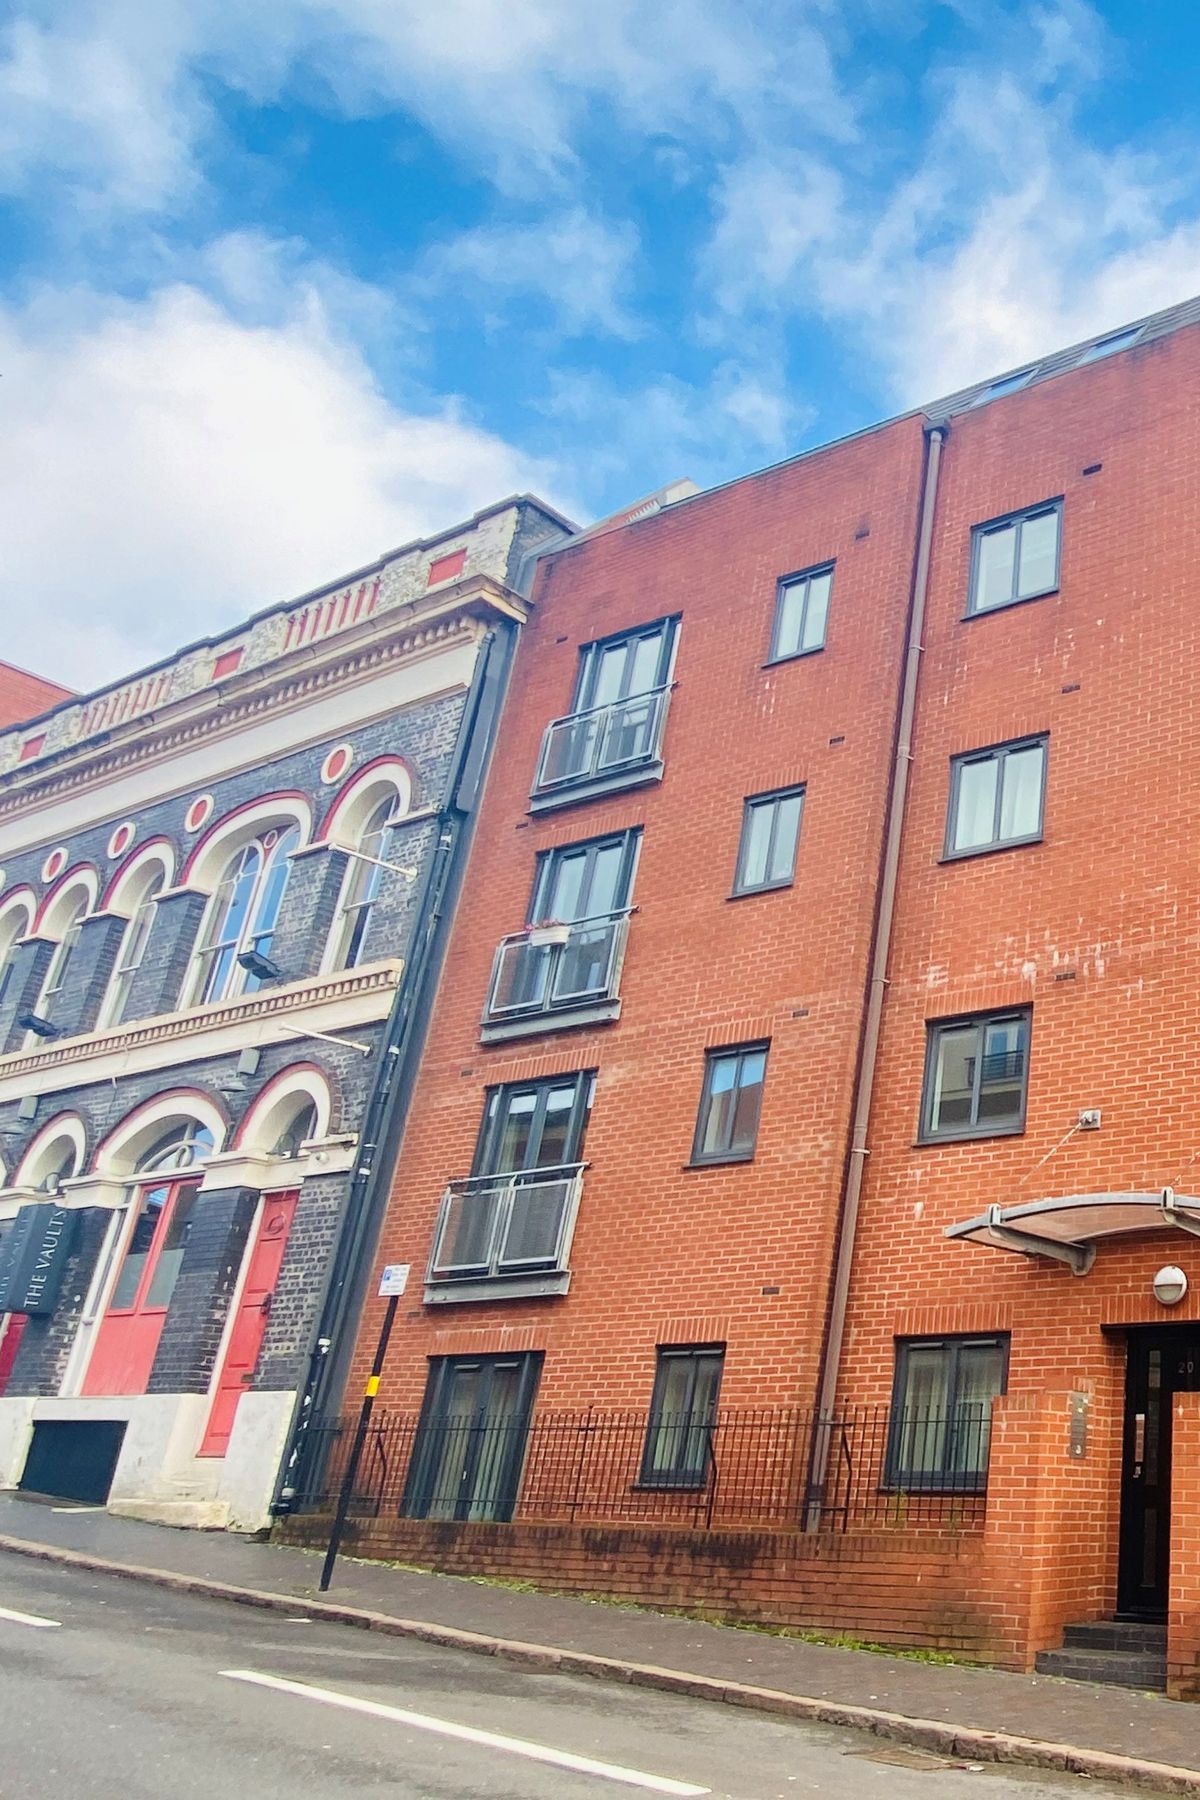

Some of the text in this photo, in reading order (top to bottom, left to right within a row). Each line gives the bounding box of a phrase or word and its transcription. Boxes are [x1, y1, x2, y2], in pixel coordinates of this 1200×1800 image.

[23, 1210, 67, 1307] THE VAULTS
[1178, 1361, 1194, 1374] 20
